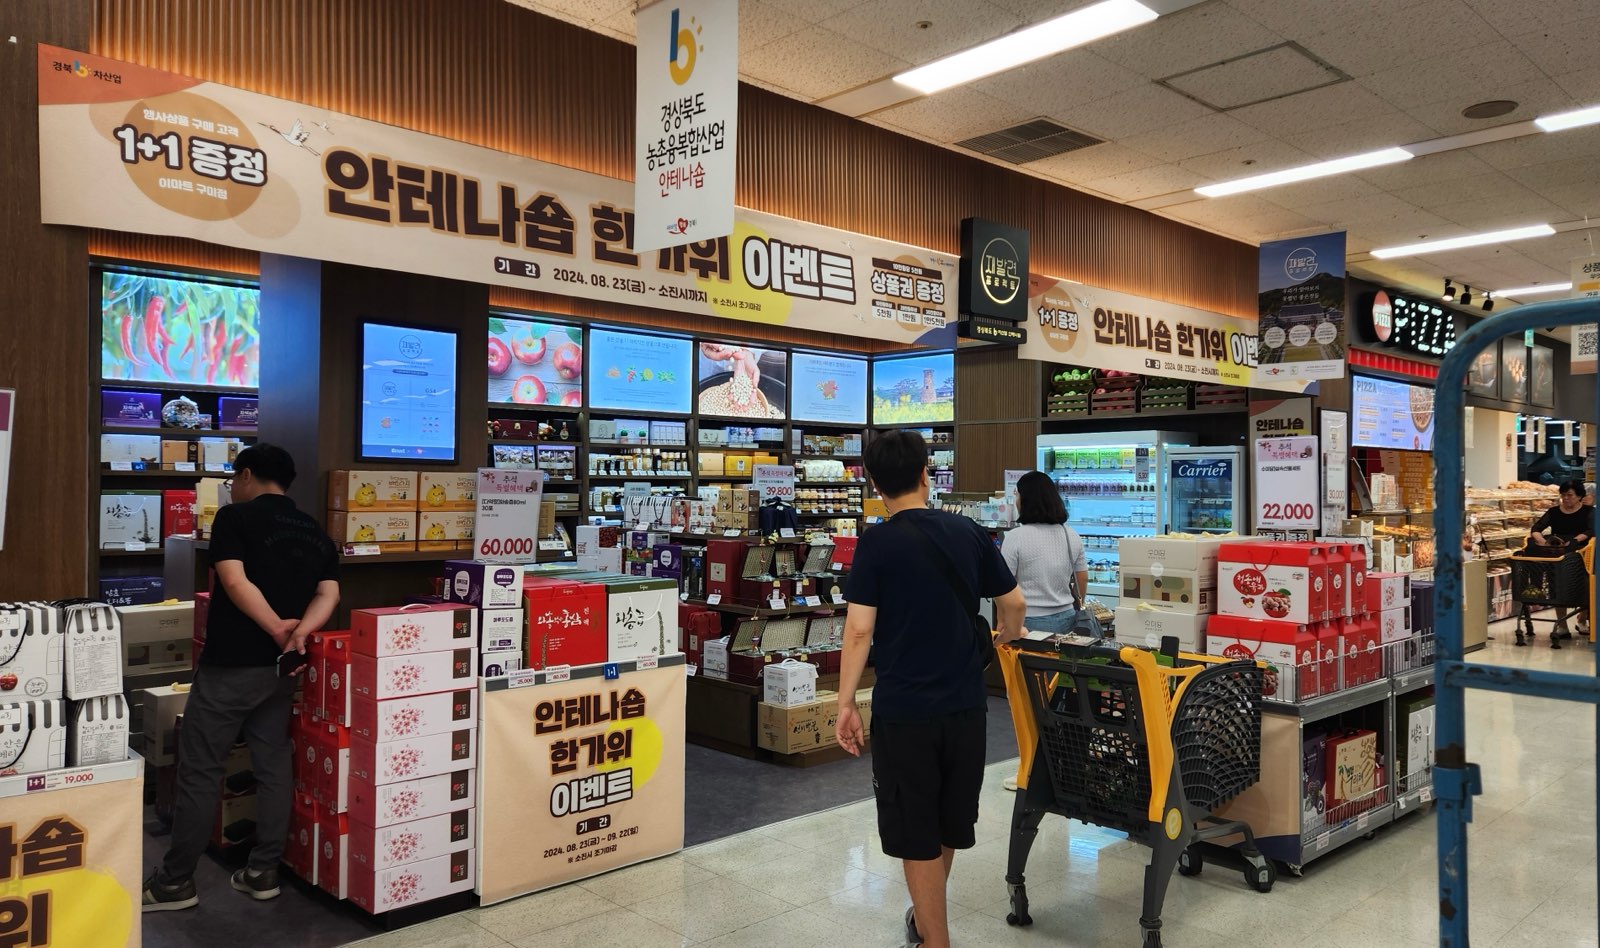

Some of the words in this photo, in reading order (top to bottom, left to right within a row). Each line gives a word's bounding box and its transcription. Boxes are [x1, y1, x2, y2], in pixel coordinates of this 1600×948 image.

[52, 60, 73, 75] 경북
[143, 107, 190, 128] 행사상품
[191, 118, 215, 133] 구매
[216, 122, 239, 138] 고객
[661, 92, 706, 133] 경상북도
[114, 125, 182, 170] 1+1
[188, 137, 267, 187] 증정
[646, 119, 725, 172] 농촌융복합산업
[158, 177, 194, 193] 이마트
[195, 183, 228, 200] 구미점
[659, 161, 706, 198] 안테나숍
[325, 149, 575, 255] 안테나숍
[742, 235, 856, 305] 이벤트
[986, 254, 1018, 280] 재발견
[554, 268, 588, 285] 2024.
[591, 273, 610, 289] 08.
[612, 277, 646, 294] 23(금)
[658, 284, 708, 303] 소진시까지
[720, 298, 738, 308] 소진시
[738, 299, 762, 312] 조기마감
[871, 270, 915, 300] 상품권
[916, 279, 945, 305] 증정
[876, 308, 892, 319] 5천원
[902, 313, 917, 323] 1만원
[1038, 306, 1057, 329] 1+1
[1058, 309, 1079, 332] 증정
[1093, 307, 1172, 354] 안테나숍
[1176, 322, 1228, 361] 한가위
[1394, 298, 1457, 355] PIZZA
[1356, 380, 1377, 394] PIZZA
[1256, 418, 1304, 432] 안테나숍
[503, 475, 518, 484] 추석
[1178, 464, 1227, 477] Carrier
[496, 483, 524, 492] 특별혜택
[766, 486, 793, 496] 39,800
[1329, 489, 1345, 500] 30,000
[1262, 503, 1314, 521] 22,000
[480, 538, 533, 556] 60,000
[517, 677, 533, 685] 25,000
[535, 688, 646, 735] 안테나숍
[550, 729, 633, 775] 한가위
[28, 778, 45, 788] 1+1
[64, 773, 94, 785] 19,000
[550, 767, 633, 817] 이벤트
[544, 846, 565, 858] 2024.
[566, 842, 578, 852] 08.
[579, 836, 600, 849] 23(금)
[607, 833, 618, 842] 09.
[619, 826, 639, 839] 22(일)
[575, 850, 593, 862] 소진시
[594, 844, 618, 857] 조기마감
